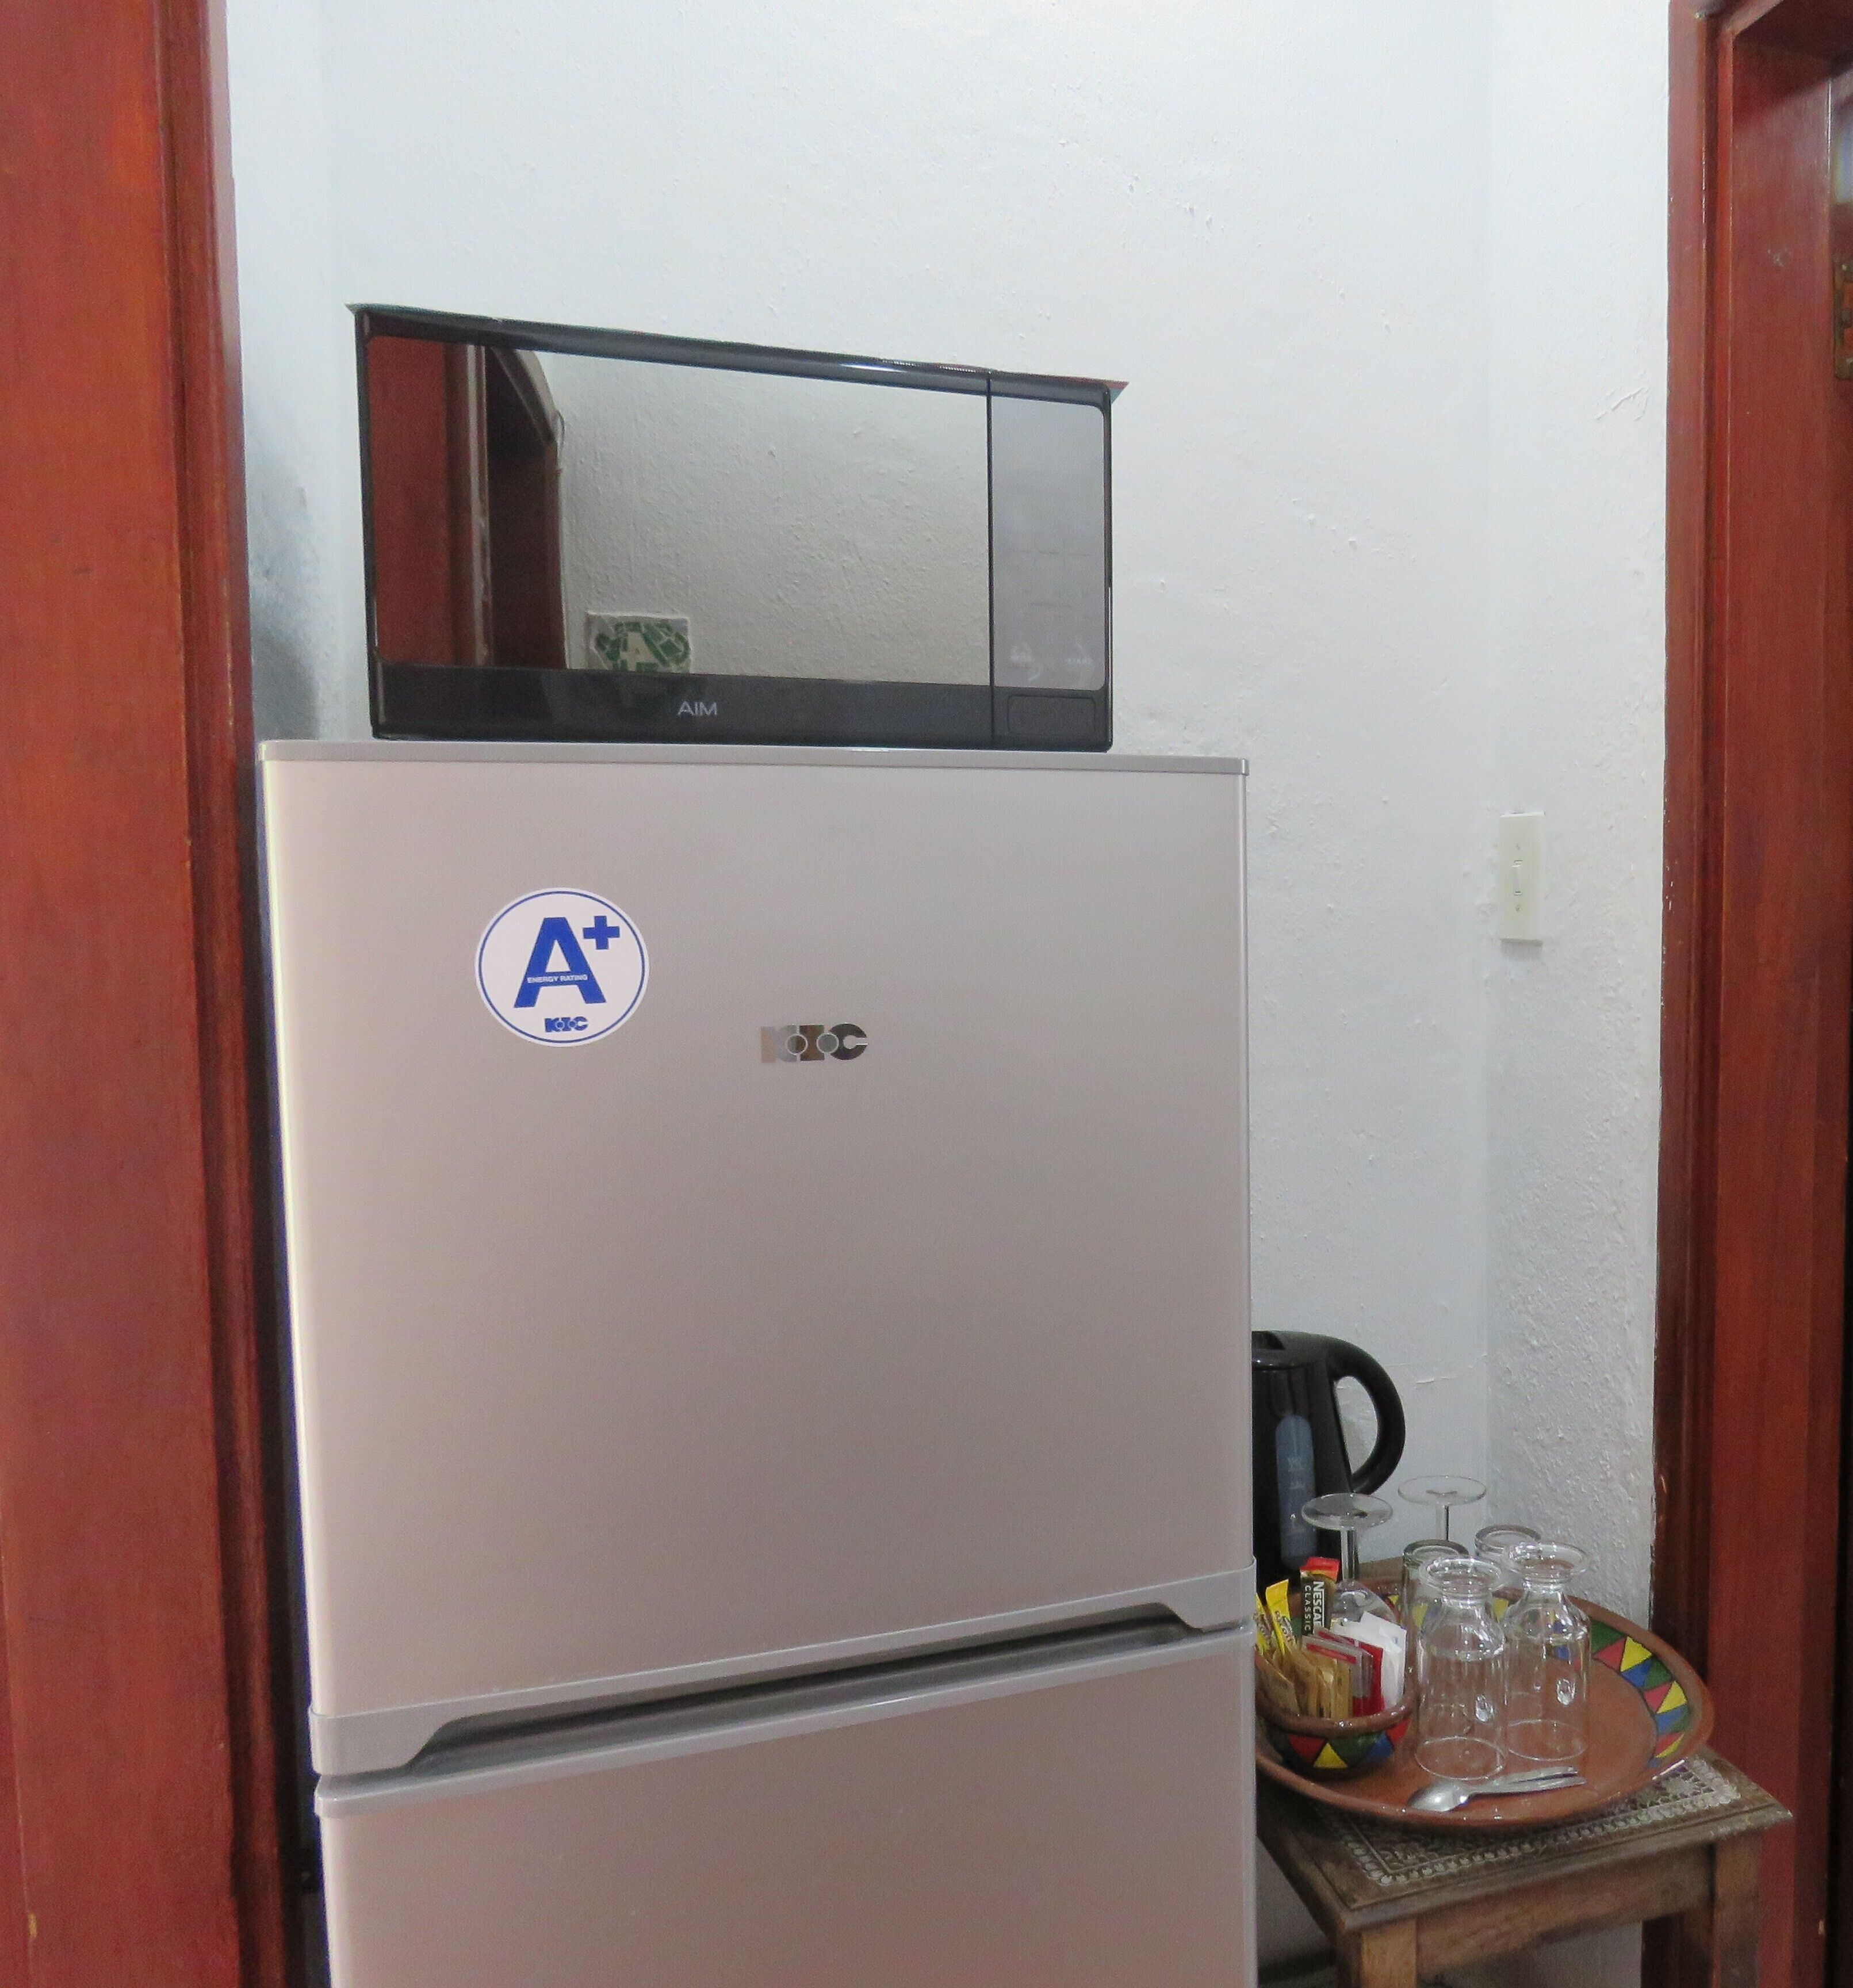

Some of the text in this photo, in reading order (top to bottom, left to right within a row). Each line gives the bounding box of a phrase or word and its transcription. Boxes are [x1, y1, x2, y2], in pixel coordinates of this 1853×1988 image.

[677, 701, 717, 716] AIM
[527, 974, 588, 984] ENERGY RATING
[1313, 1581, 1324, 1627] NESCAF
